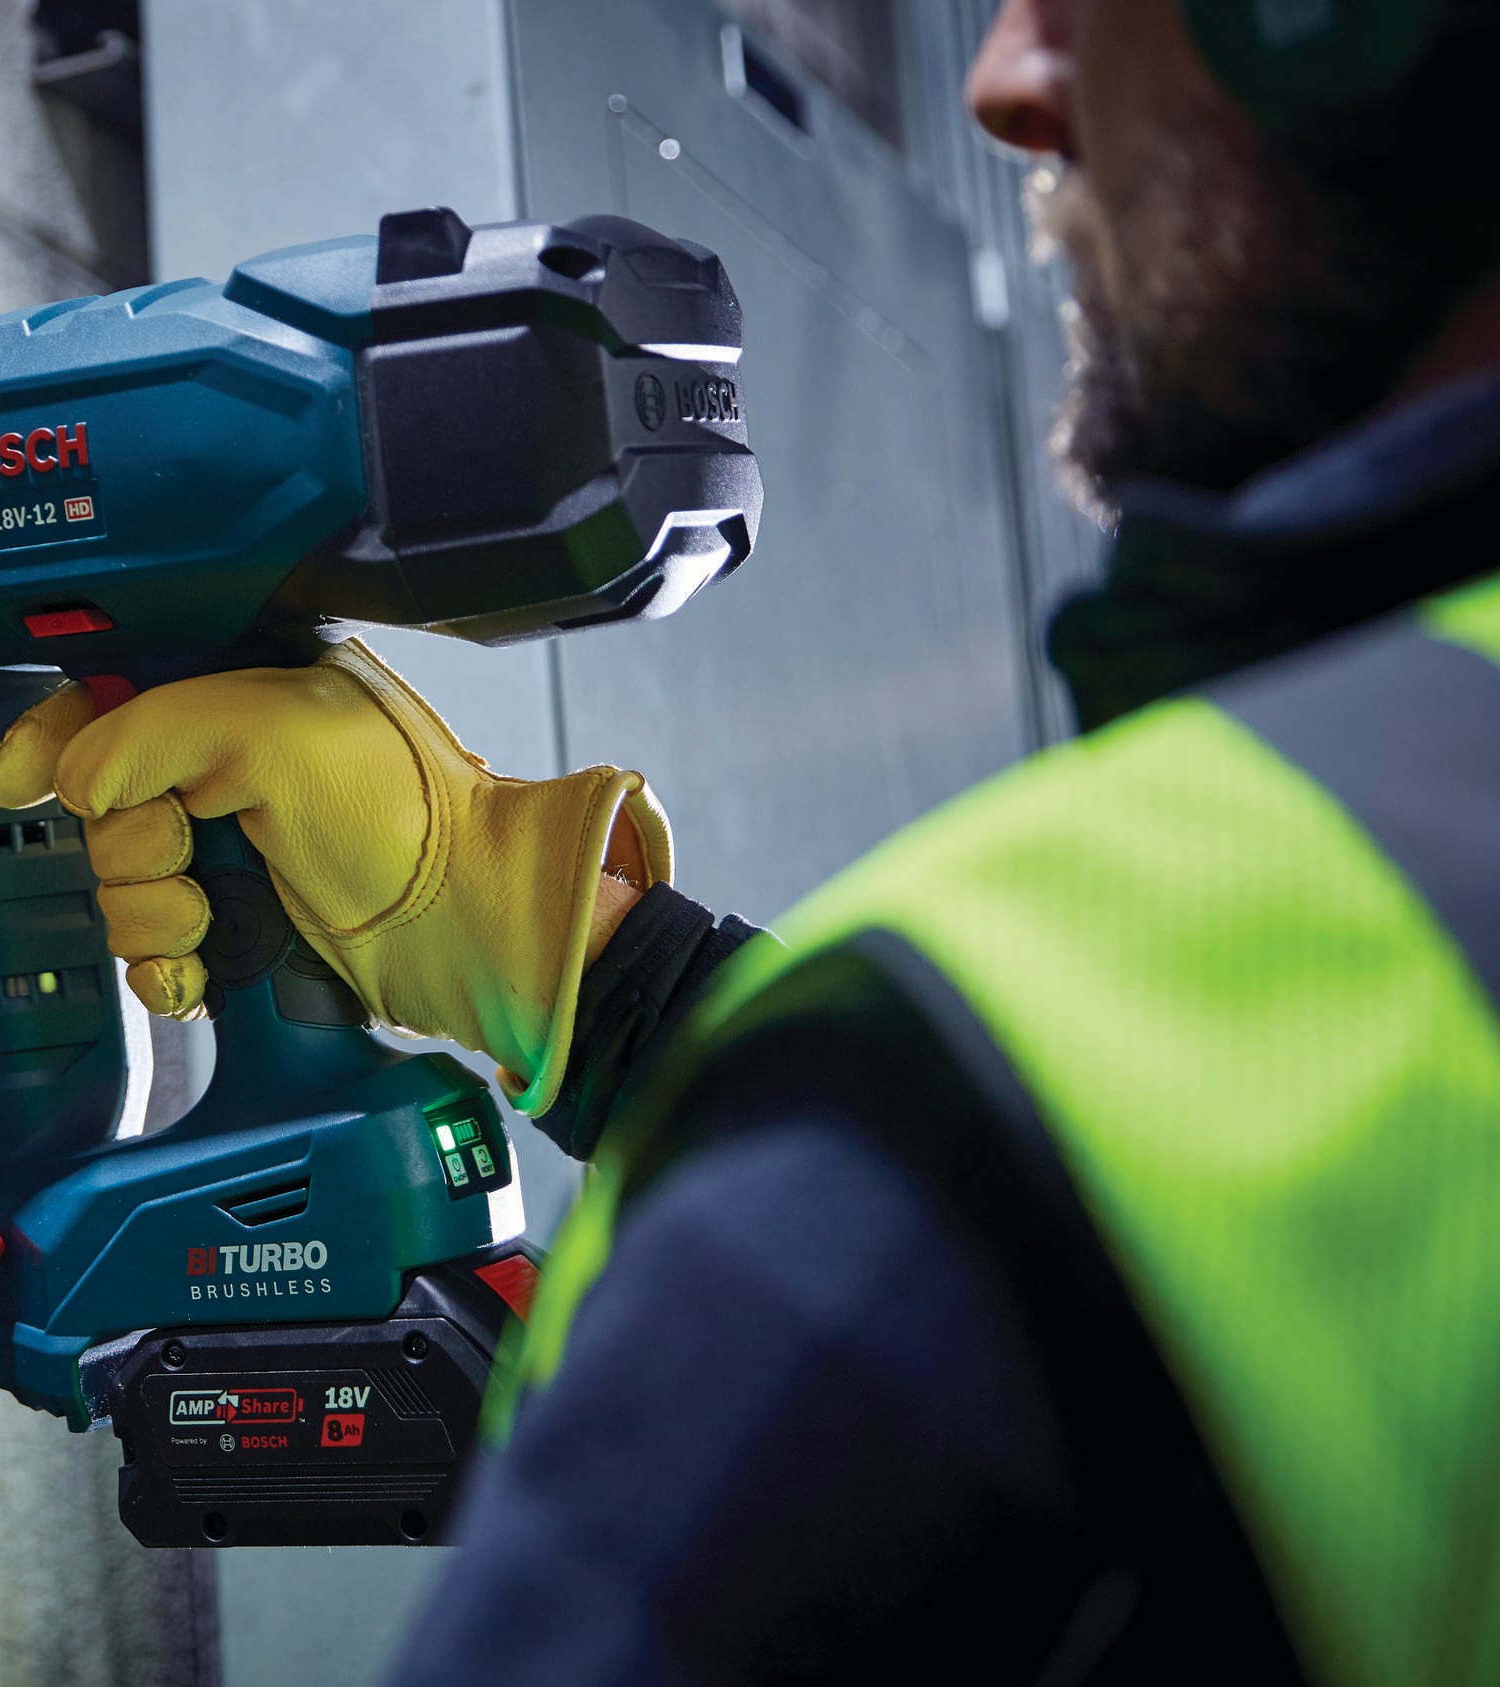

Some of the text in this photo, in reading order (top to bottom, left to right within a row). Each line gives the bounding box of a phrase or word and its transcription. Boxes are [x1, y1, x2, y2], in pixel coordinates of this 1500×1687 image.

[675, 380, 740, 422] BOSCH
[69, 502, 92, 517] HD
[190, 1278, 332, 1300] BRUSHLESS
[175, 1398, 289, 1416] AMP Share
[325, 1386, 371, 1409] 18V
[241, 1436, 288, 1449] BOSCH
